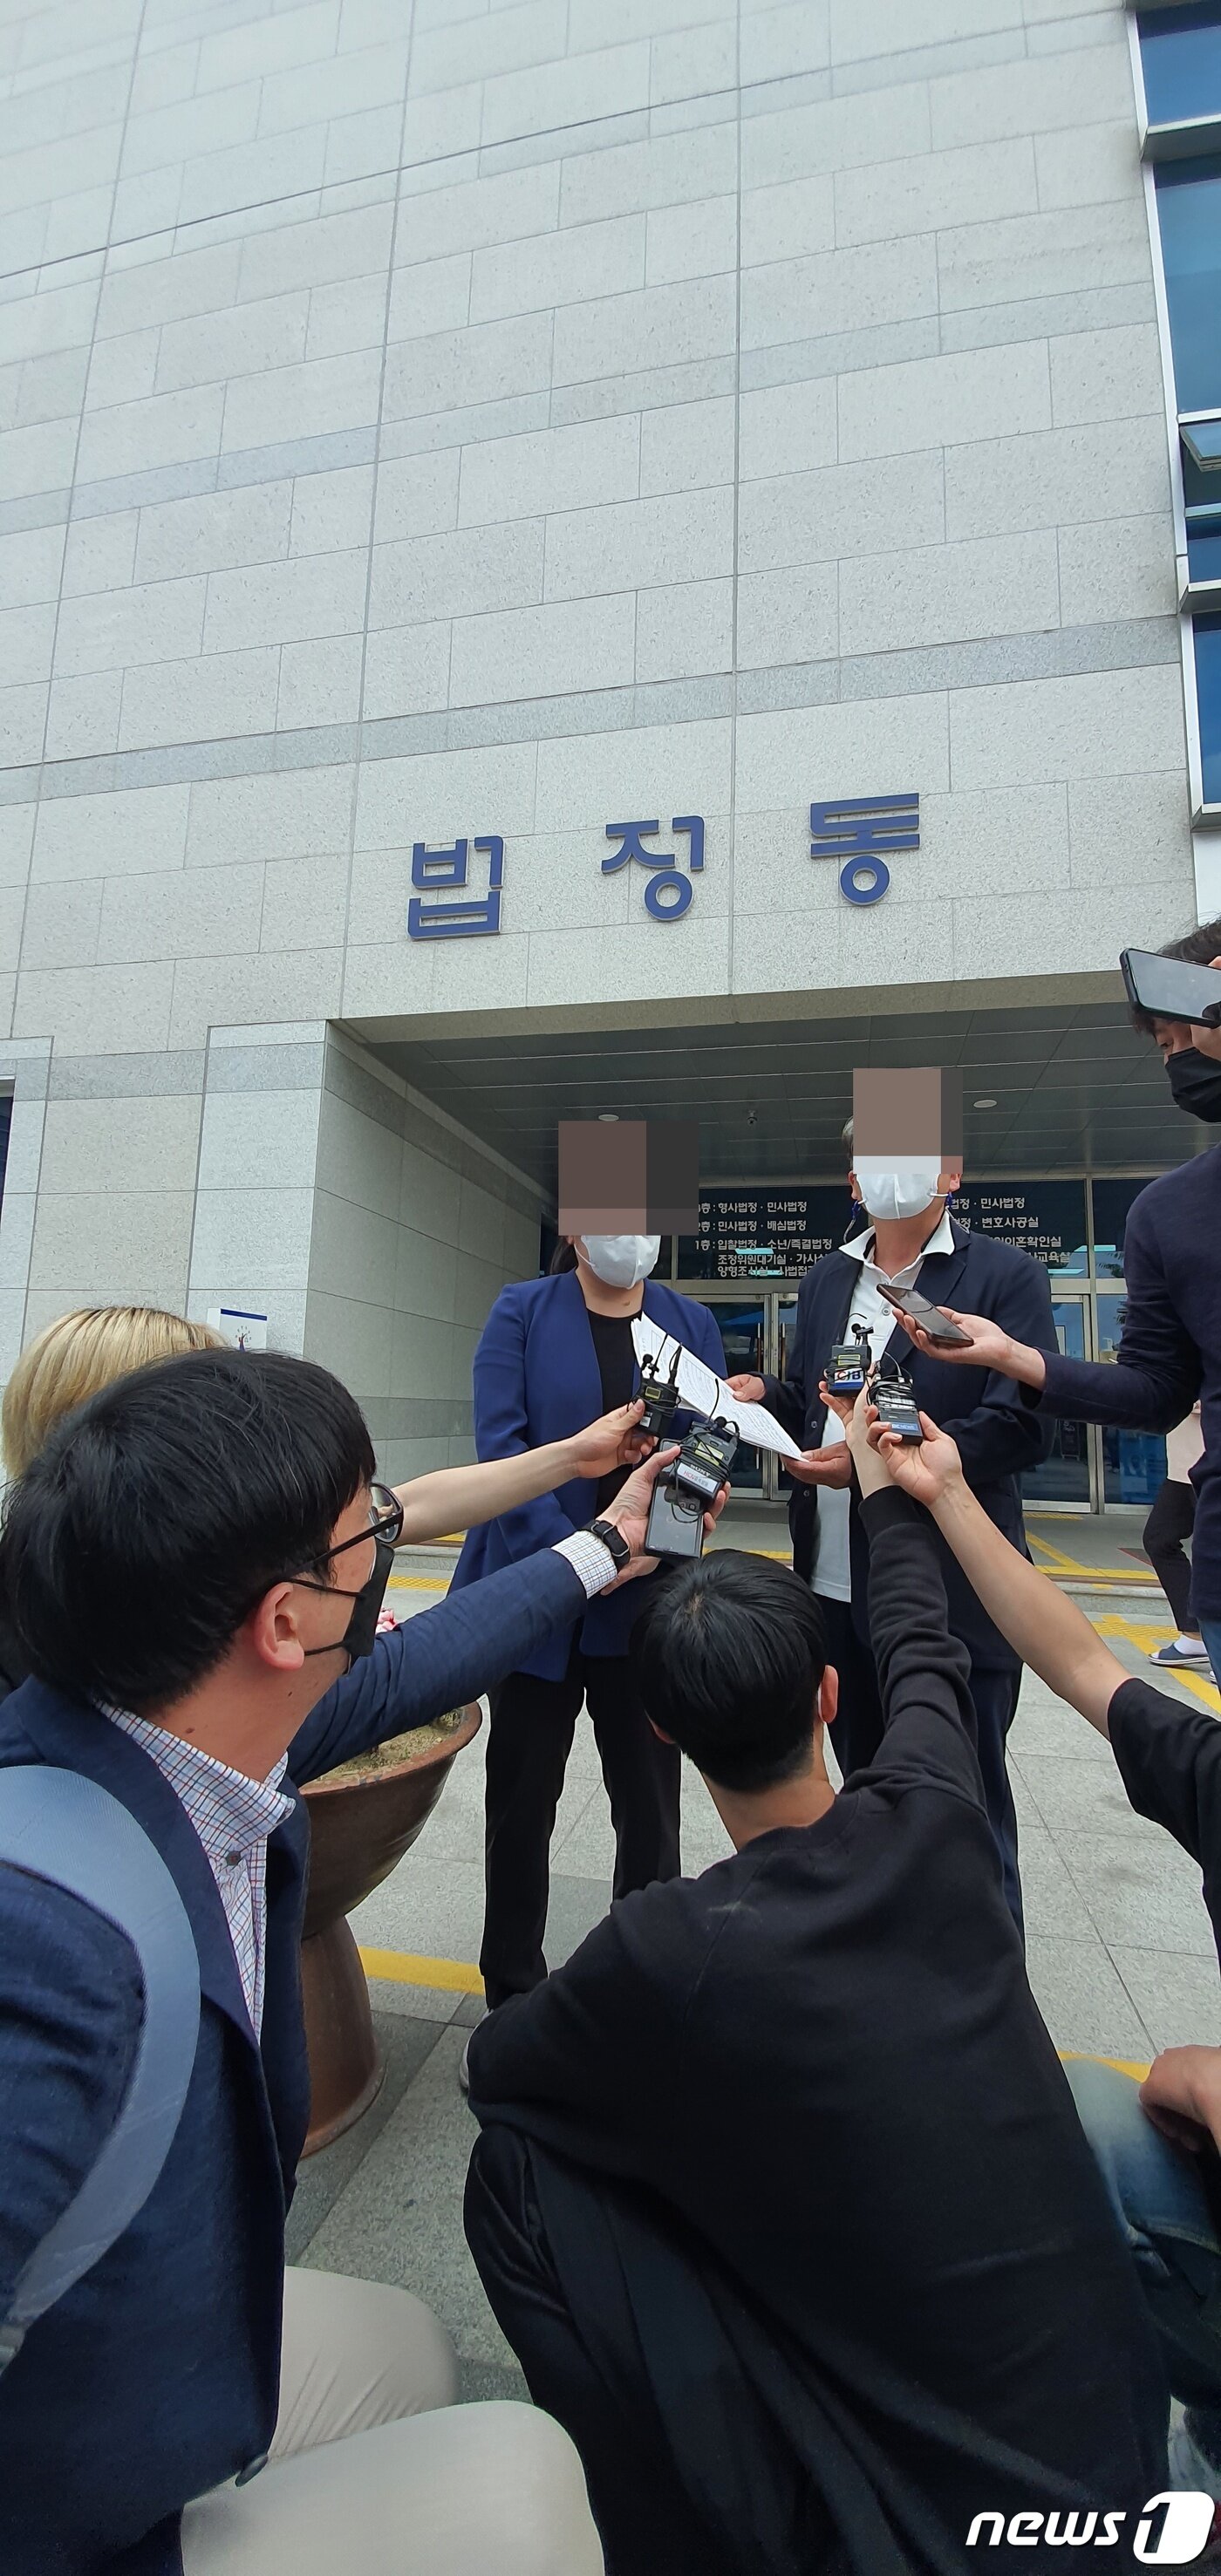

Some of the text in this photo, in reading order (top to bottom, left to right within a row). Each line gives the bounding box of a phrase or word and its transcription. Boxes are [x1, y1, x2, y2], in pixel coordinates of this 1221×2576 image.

[718, 1202, 758, 1214] 형사법정
[767, 1201, 808, 1213] 민사법정
[980, 1197, 1026, 1210] 민사법정
[718, 1221, 757, 1232] 민사법정
[767, 1220, 807, 1231] 배심법정
[981, 1216, 1040, 1229] 변호사공실
[778, 1265, 814, 1277] 사법접
